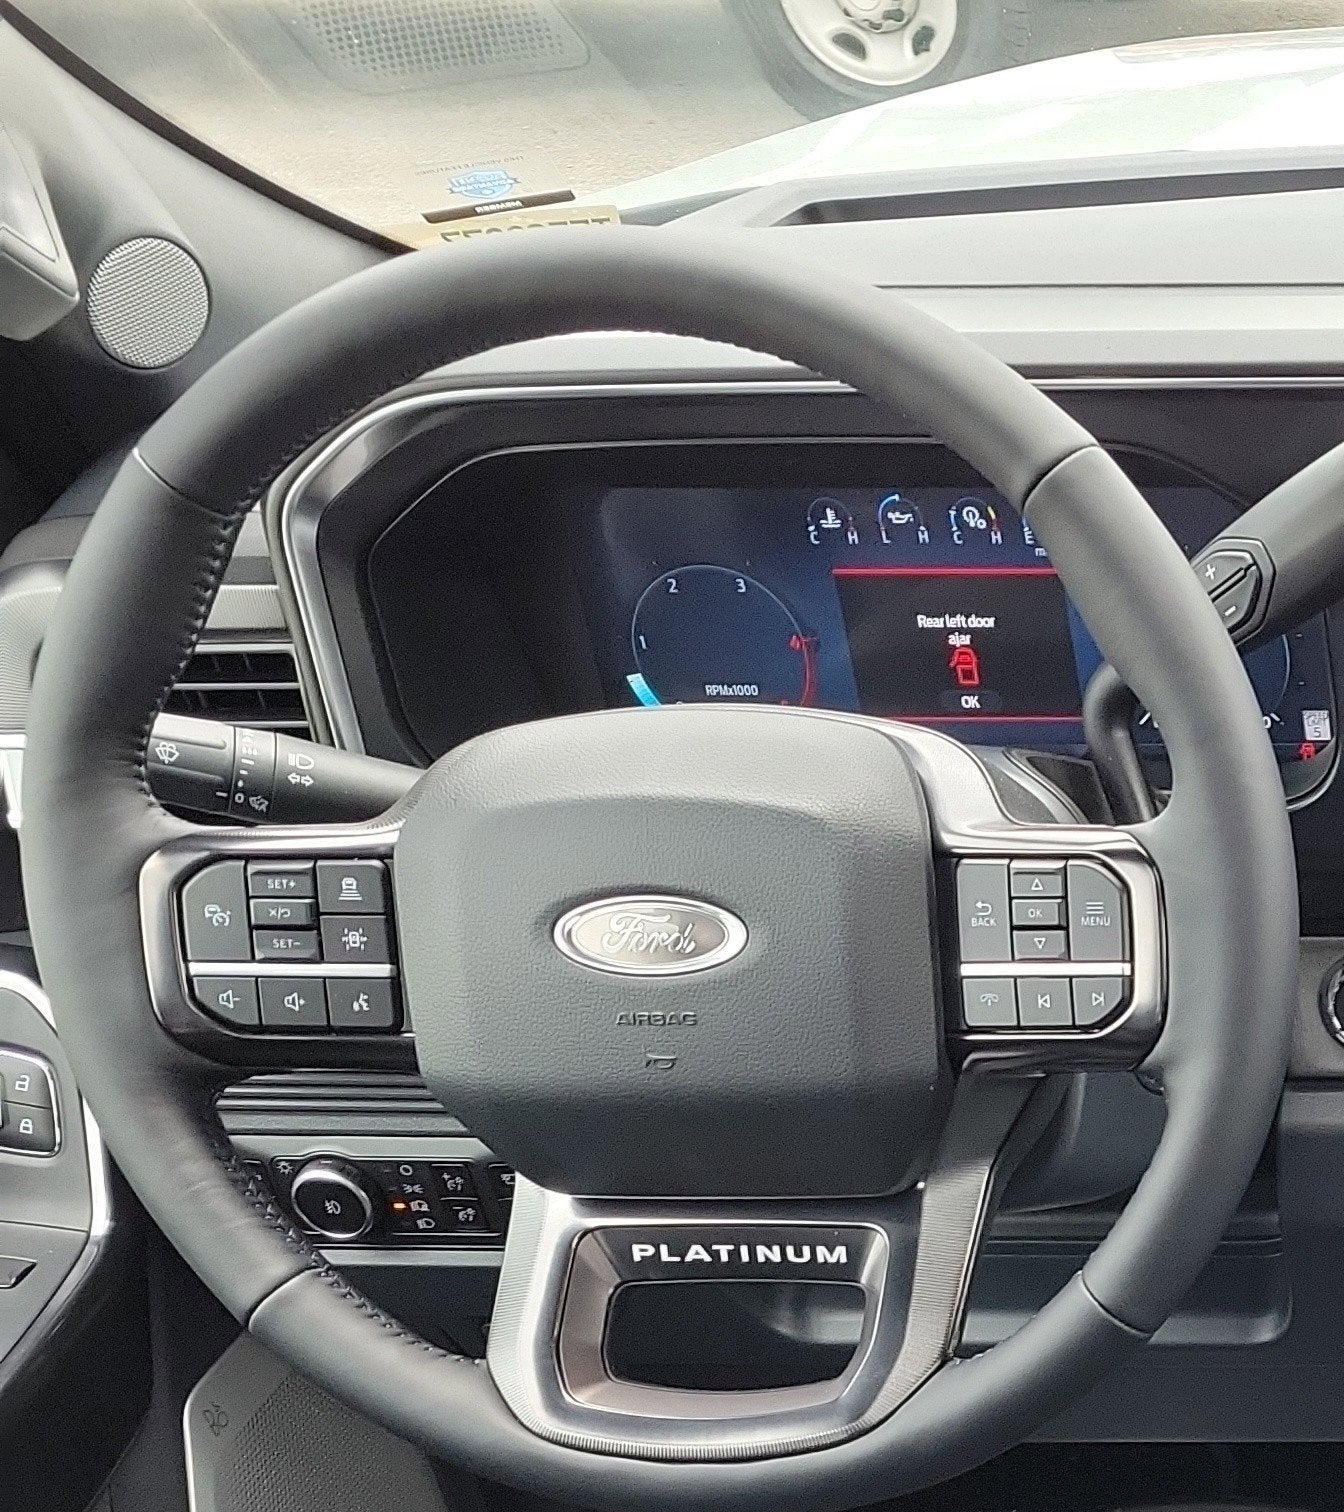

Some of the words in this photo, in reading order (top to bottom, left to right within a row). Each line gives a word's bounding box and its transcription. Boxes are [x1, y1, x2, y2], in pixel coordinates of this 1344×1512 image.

[666, 578, 679, 594] 2
[735, 578, 747, 594] 3
[917, 614, 944, 629] Rear
[945, 613, 966, 629] left
[967, 613, 996, 629] door
[948, 632, 972, 648] ajar
[705, 684, 759, 697] RPMx1000
[960, 696, 980, 709] OK
[267, 878, 297, 890] SET+
[1028, 908, 1043, 918] OK
[971, 917, 997, 927] BACK
[1081, 917, 1111, 926] MENU
[601, 911, 696, 955] Ford
[614, 1011, 698, 1027] AIRBAG
[631, 1242, 849, 1265] PLATINUM
